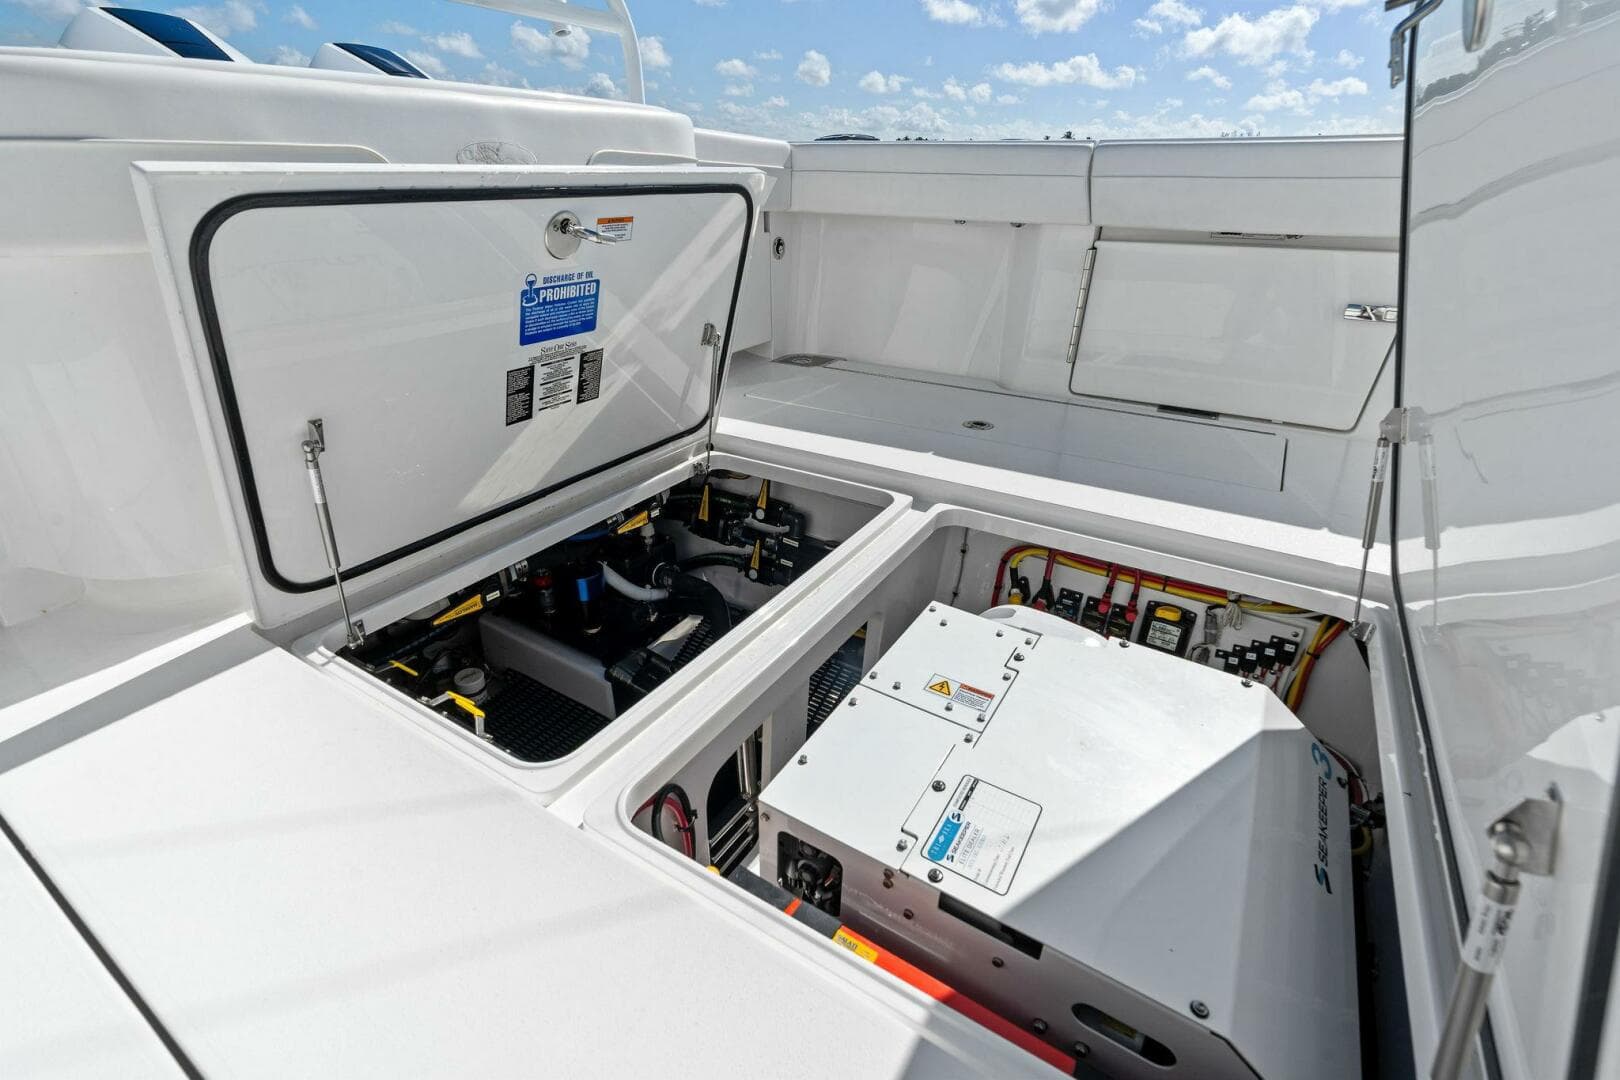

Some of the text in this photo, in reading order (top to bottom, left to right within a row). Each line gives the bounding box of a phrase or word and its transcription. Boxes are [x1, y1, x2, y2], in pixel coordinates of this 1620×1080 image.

[543, 271, 594, 284] DISCHARGE OF OIL
[539, 282, 597, 303] PROHIBITED
[1311, 742, 1332, 780] 3
[1318, 776, 1329, 867] SEAKEEPER
